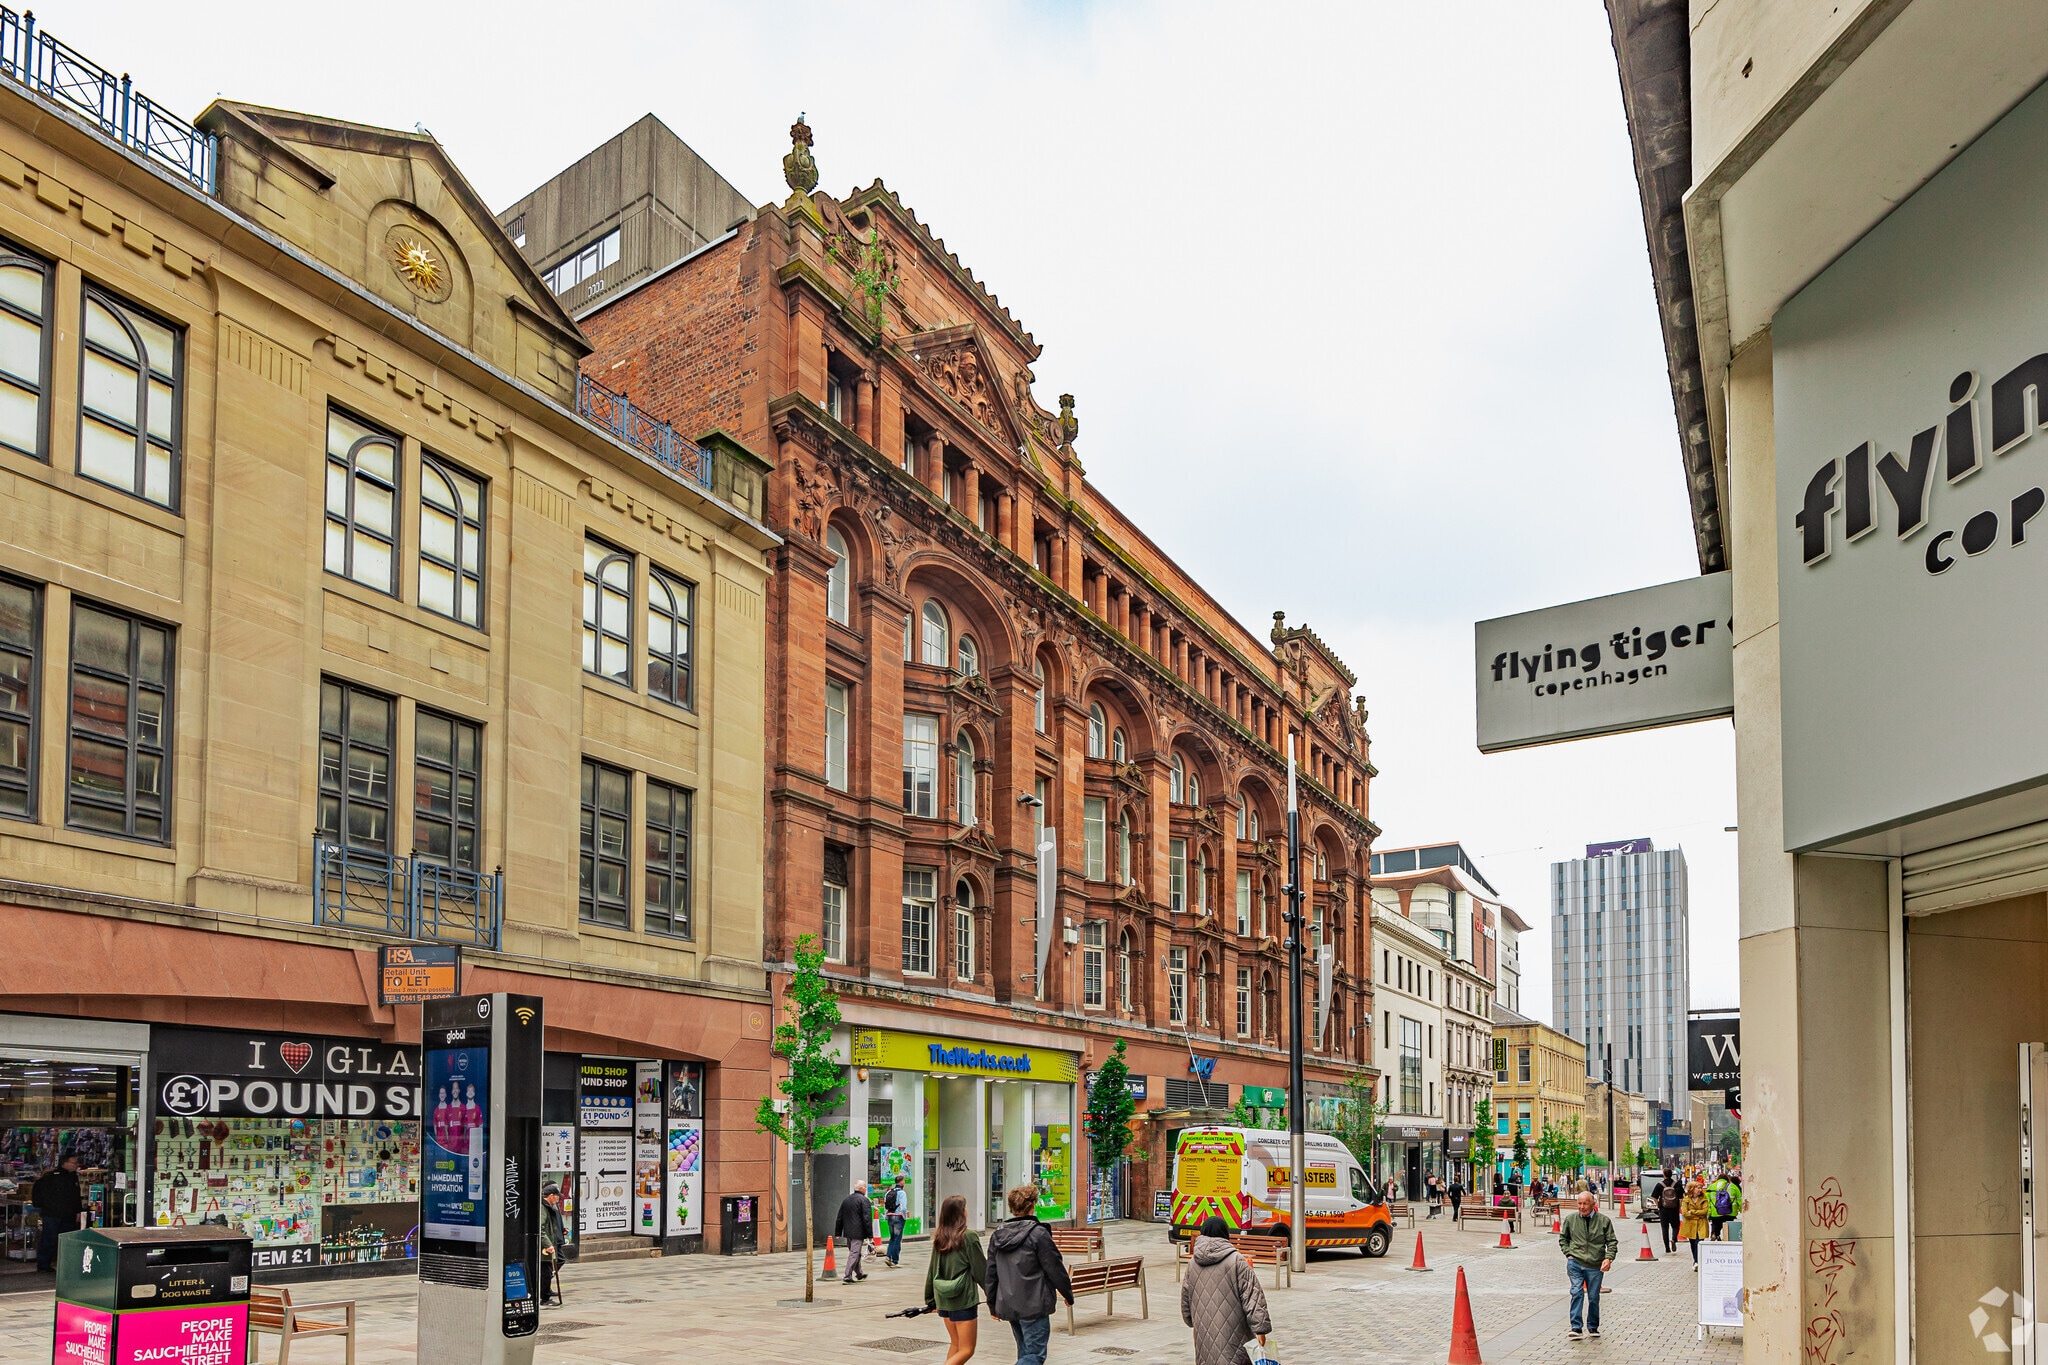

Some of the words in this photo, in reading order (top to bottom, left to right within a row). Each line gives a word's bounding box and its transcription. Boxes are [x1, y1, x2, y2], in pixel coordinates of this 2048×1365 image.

[1795, 353, 2048, 567] flyin
[1925, 486, 2047, 576] cop
[1491, 643, 1601, 683] flying
[1609, 620, 1716, 661] tiger
[1535, 664, 1667, 697] copenhagen
[387, 949, 415, 963] HSA
[384, 968, 408, 976] Retail
[410, 968, 426, 976] Unit
[385, 976, 402, 987] TO
[407, 976, 431, 987] LET
[751, 1017, 762, 1025] 154
[446, 1029, 466, 1044] global
[928, 1043, 1031, 1072] TheWorks.co.uk
[1701, 1034, 1741, 1066] W
[248, 1040, 266, 1069] I
[326, 1046, 421, 1076] GLA
[604, 1067, 628, 1076] SHOP
[1692, 1072, 1741, 1080] WATERSTO
[604, 1078, 628, 1087] SHOP
[169, 1081, 204, 1108] £1
[208, 1079, 376, 1116] POUND
[431, 1173, 463, 1182] IMMEDIATE
[1268, 1168, 1335, 1185] HOLASTERS
[431, 1184, 463, 1192] HYDRATION
[1329, 1210, 1345, 1218] 1500
[251, 1250, 287, 1267] TEM
[291, 1248, 313, 1264] £1
[161, 1290, 181, 1298] DOG
[182, 1288, 211, 1297] WASTE
[84, 1320, 107, 1336] PEOPLE
[181, 1318, 233, 1334] PEOPLE
[88, 1334, 106, 1348] MAKE
[192, 1329, 232, 1344] MAKE
[65, 1341, 105, 1364] SAUCHIEHALL
[133, 1341, 231, 1363] SAUCHIEHALL
[181, 1352, 231, 1365] STREET
